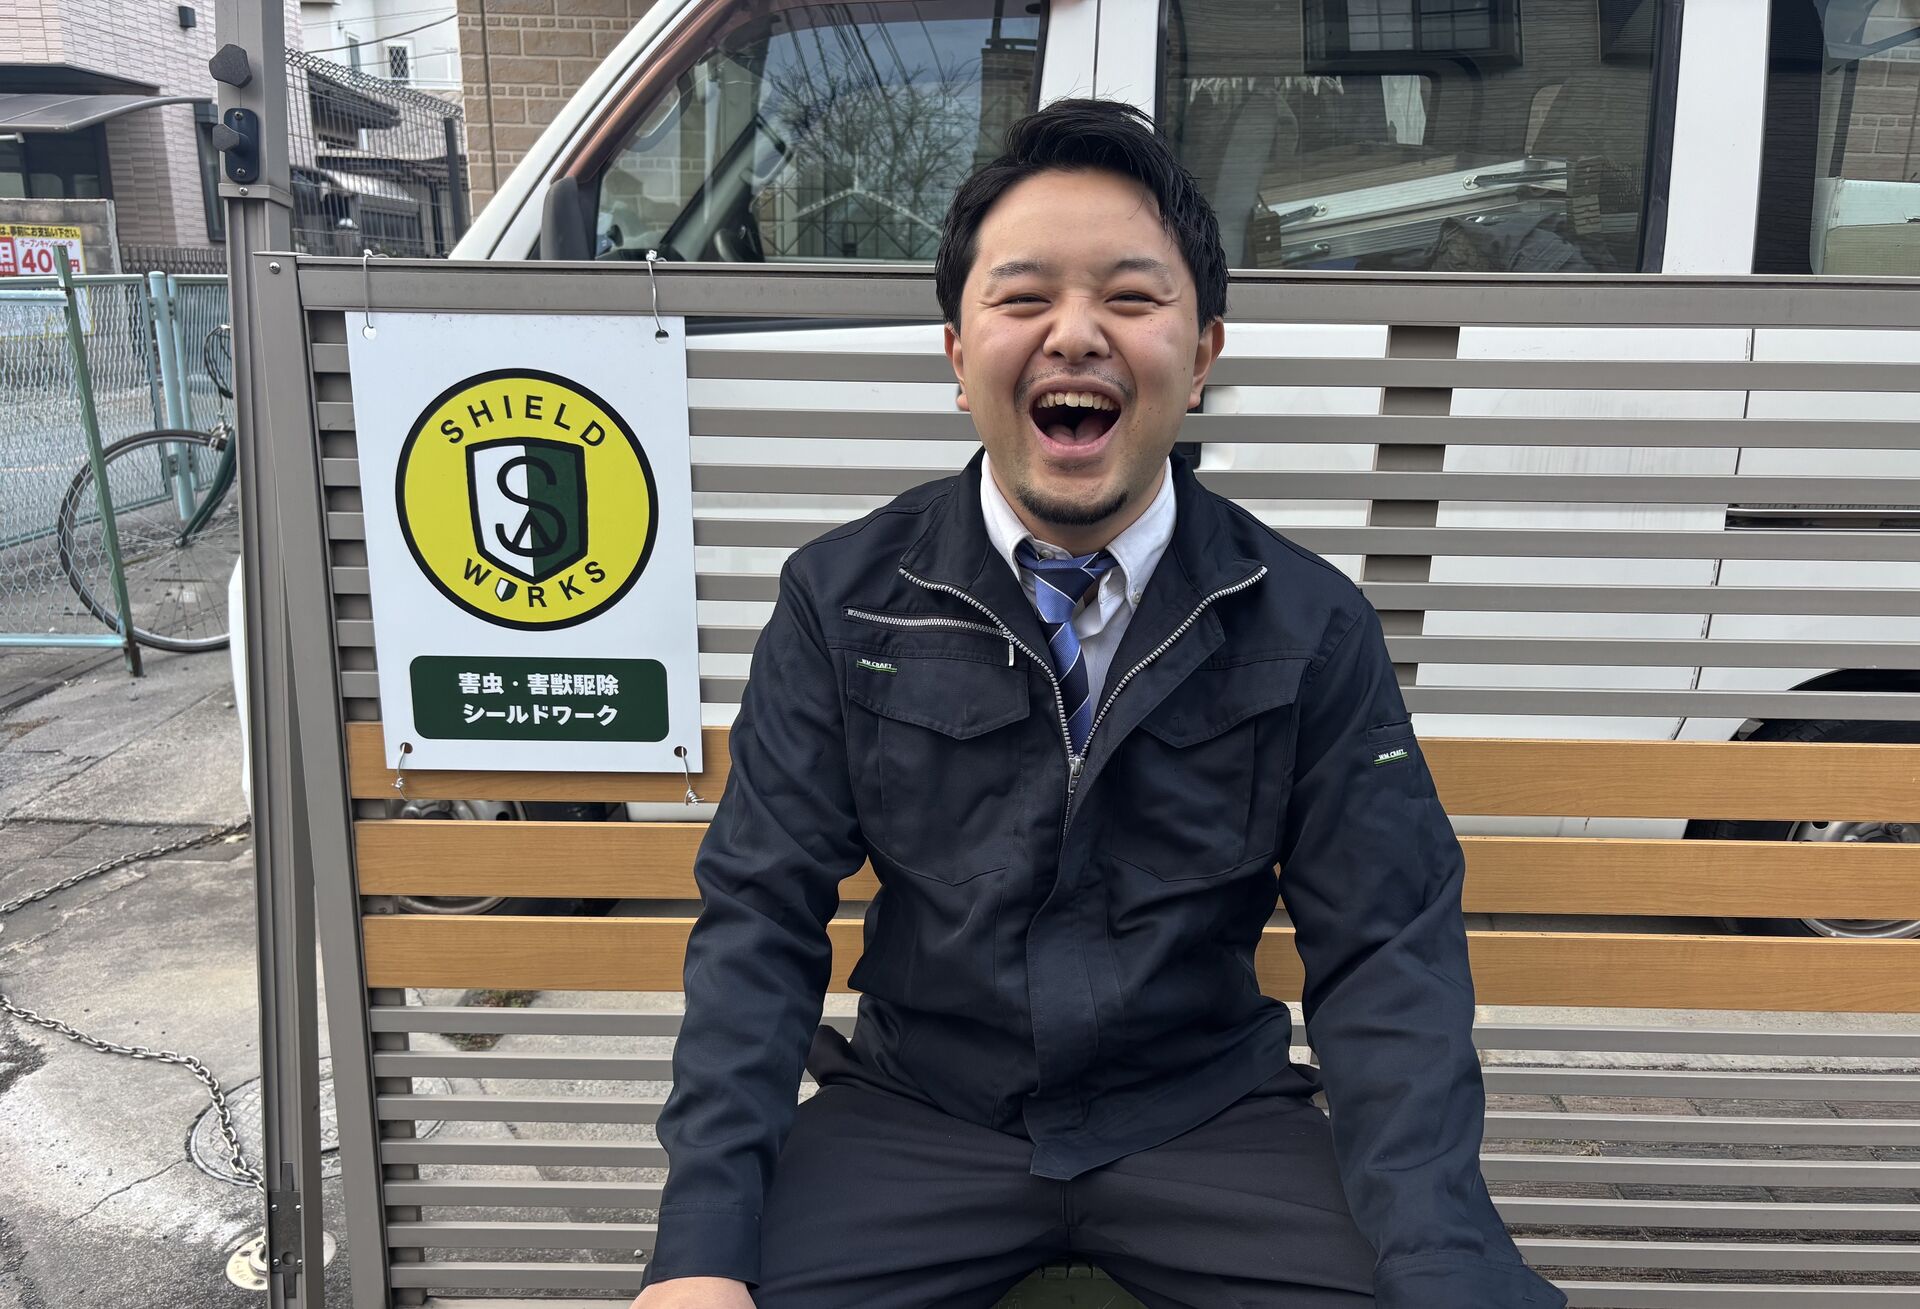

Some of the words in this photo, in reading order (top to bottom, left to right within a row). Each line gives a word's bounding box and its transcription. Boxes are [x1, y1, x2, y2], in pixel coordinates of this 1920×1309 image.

[22, 249, 80, 273] 40円
[441, 395, 606, 446] SHIELD
[458, 672, 619, 696] 害虫・害獣駆除
[463, 703, 618, 727] シールドワーク
